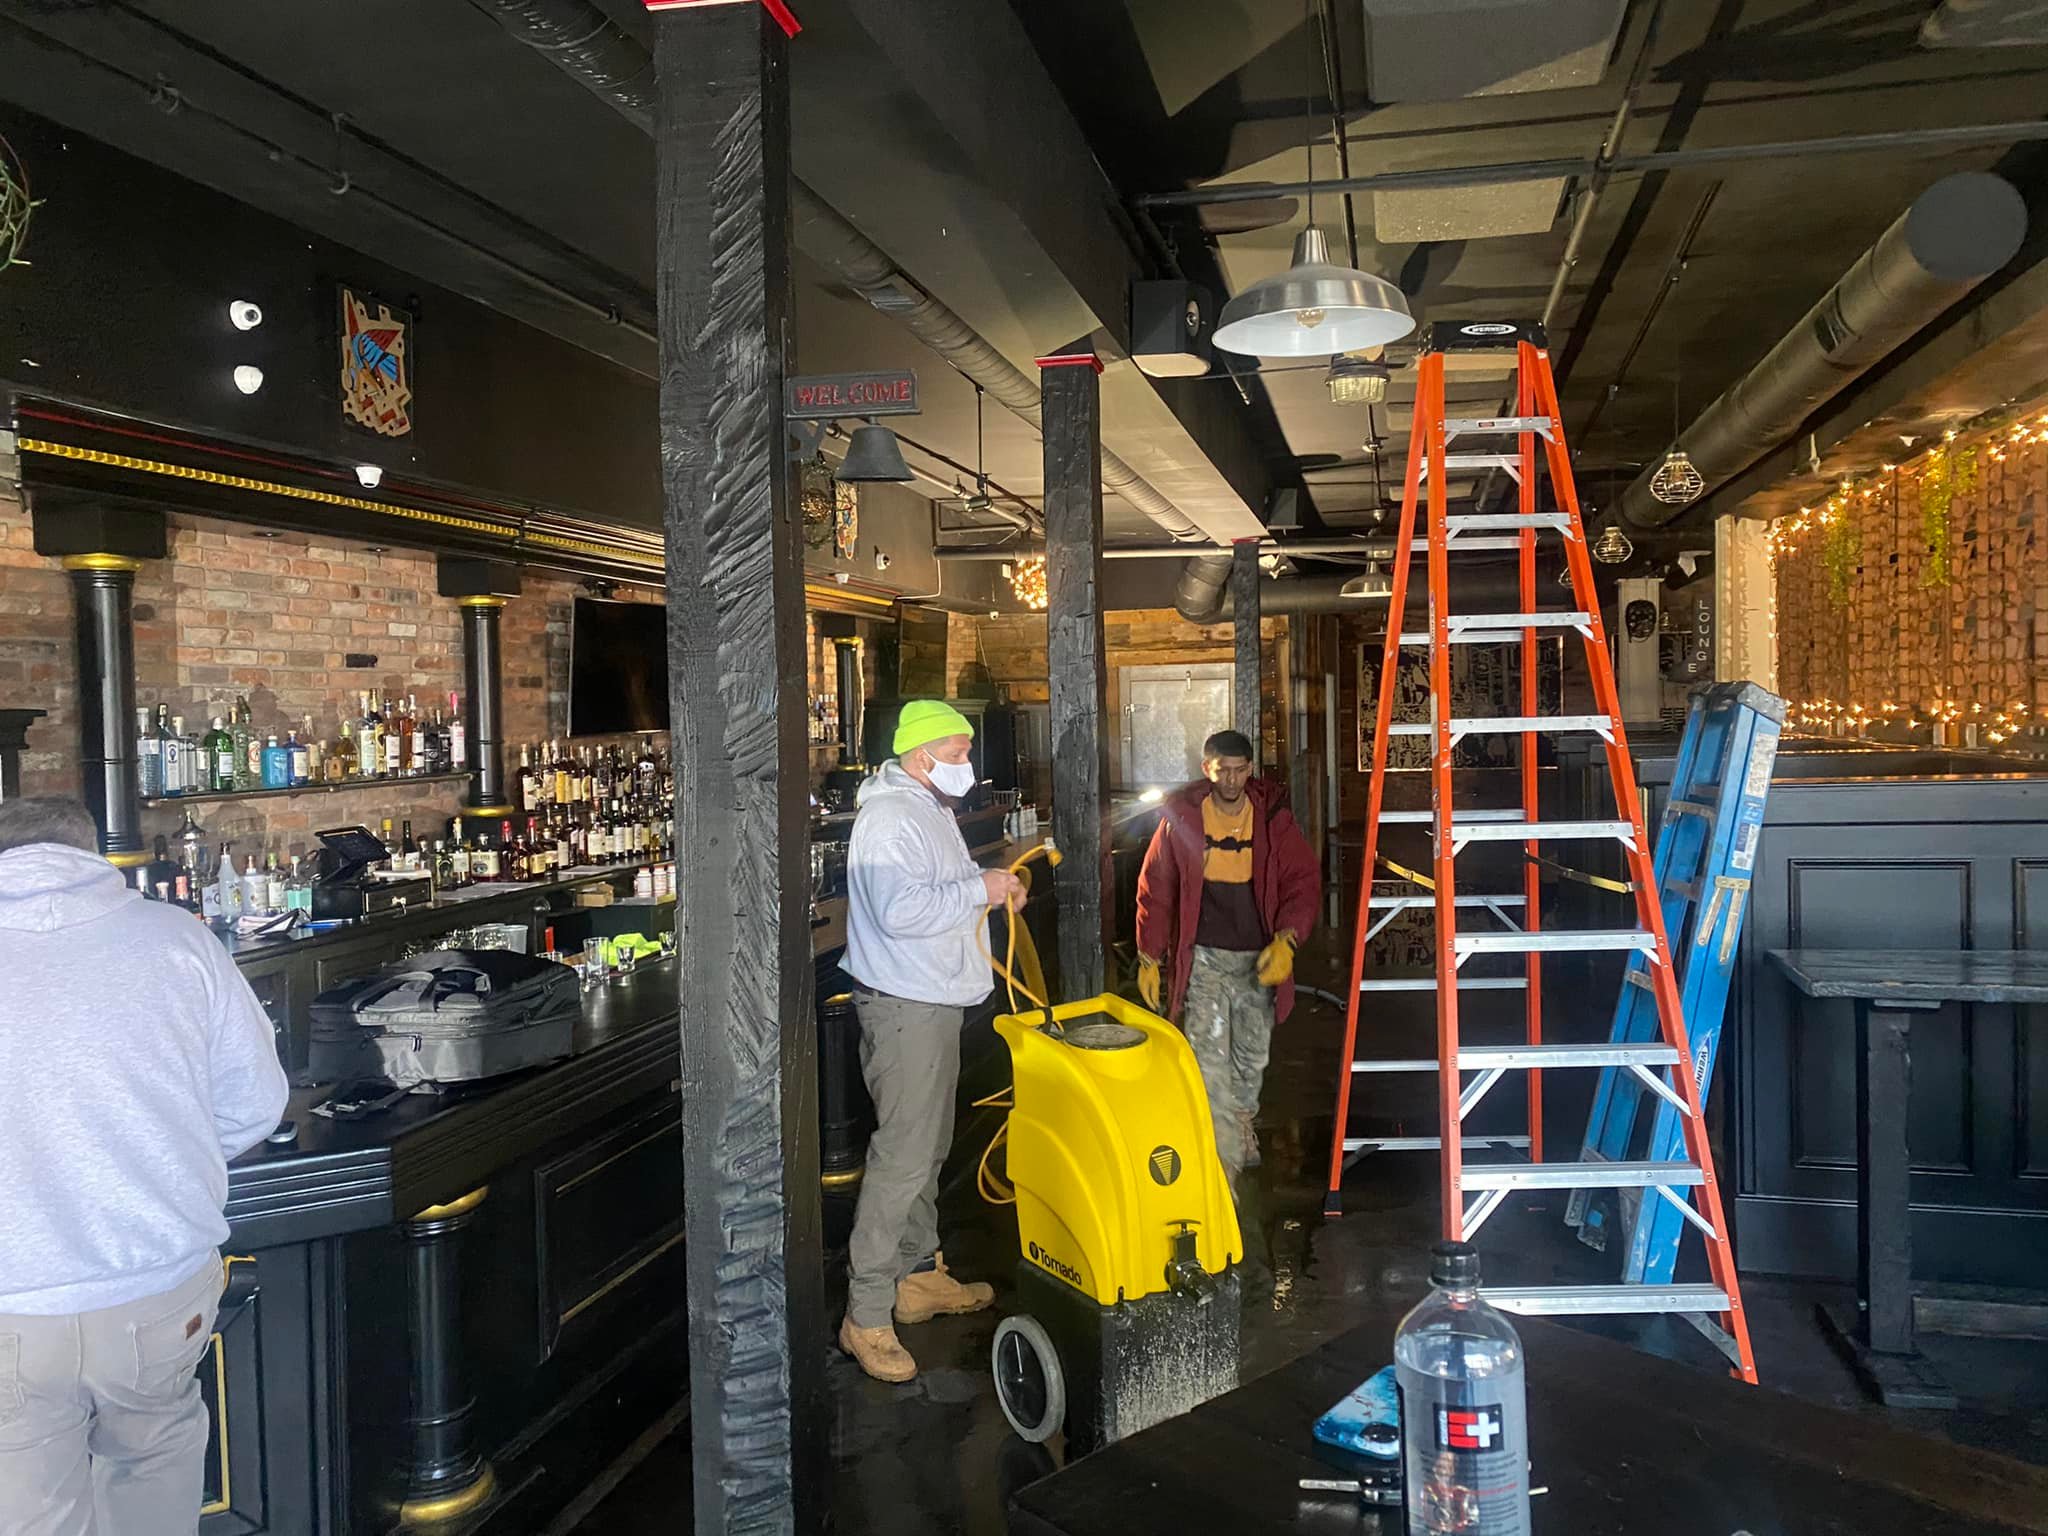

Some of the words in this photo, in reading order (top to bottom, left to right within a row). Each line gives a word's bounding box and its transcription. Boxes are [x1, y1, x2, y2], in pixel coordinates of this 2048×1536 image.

[796, 380, 912, 405] WELCOME
[1688, 599, 1711, 673] LOUNGE
[1039, 1247, 1082, 1286] Tornado
